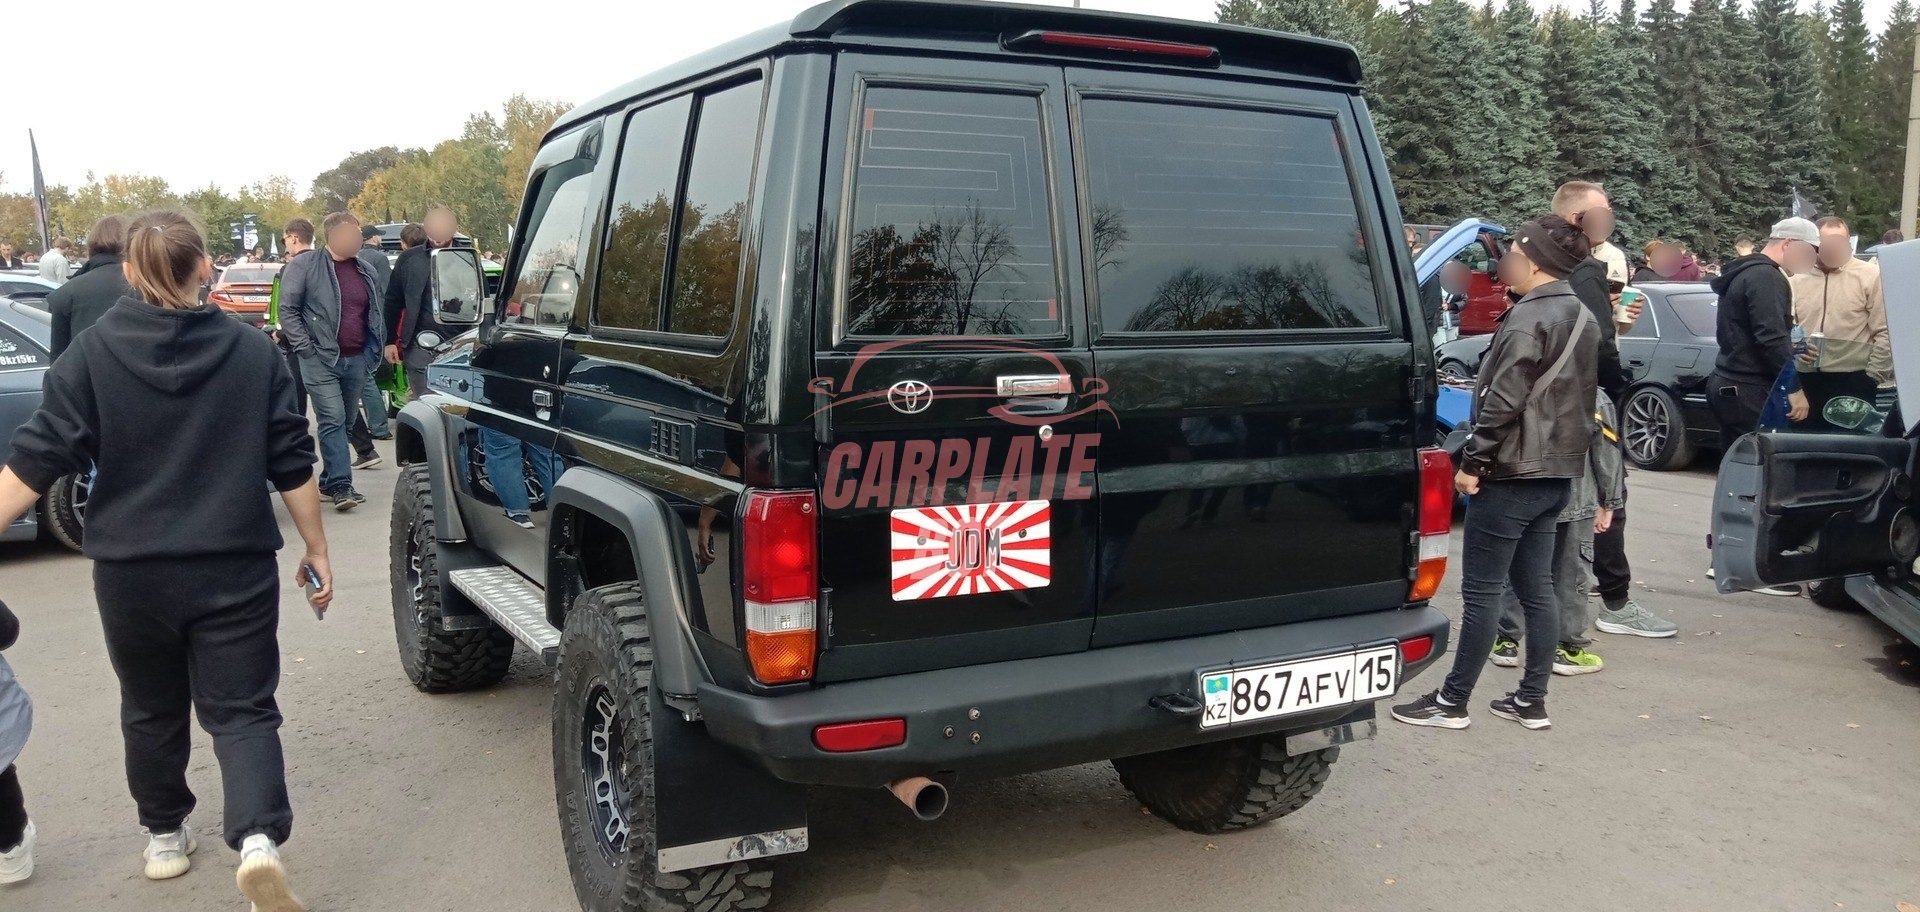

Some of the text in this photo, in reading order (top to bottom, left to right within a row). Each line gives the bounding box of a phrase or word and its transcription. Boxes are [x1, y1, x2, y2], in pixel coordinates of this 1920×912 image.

[945, 528, 1002, 571] JDM
[1205, 703, 1227, 721] KZ
[1358, 654, 1393, 694] 15
